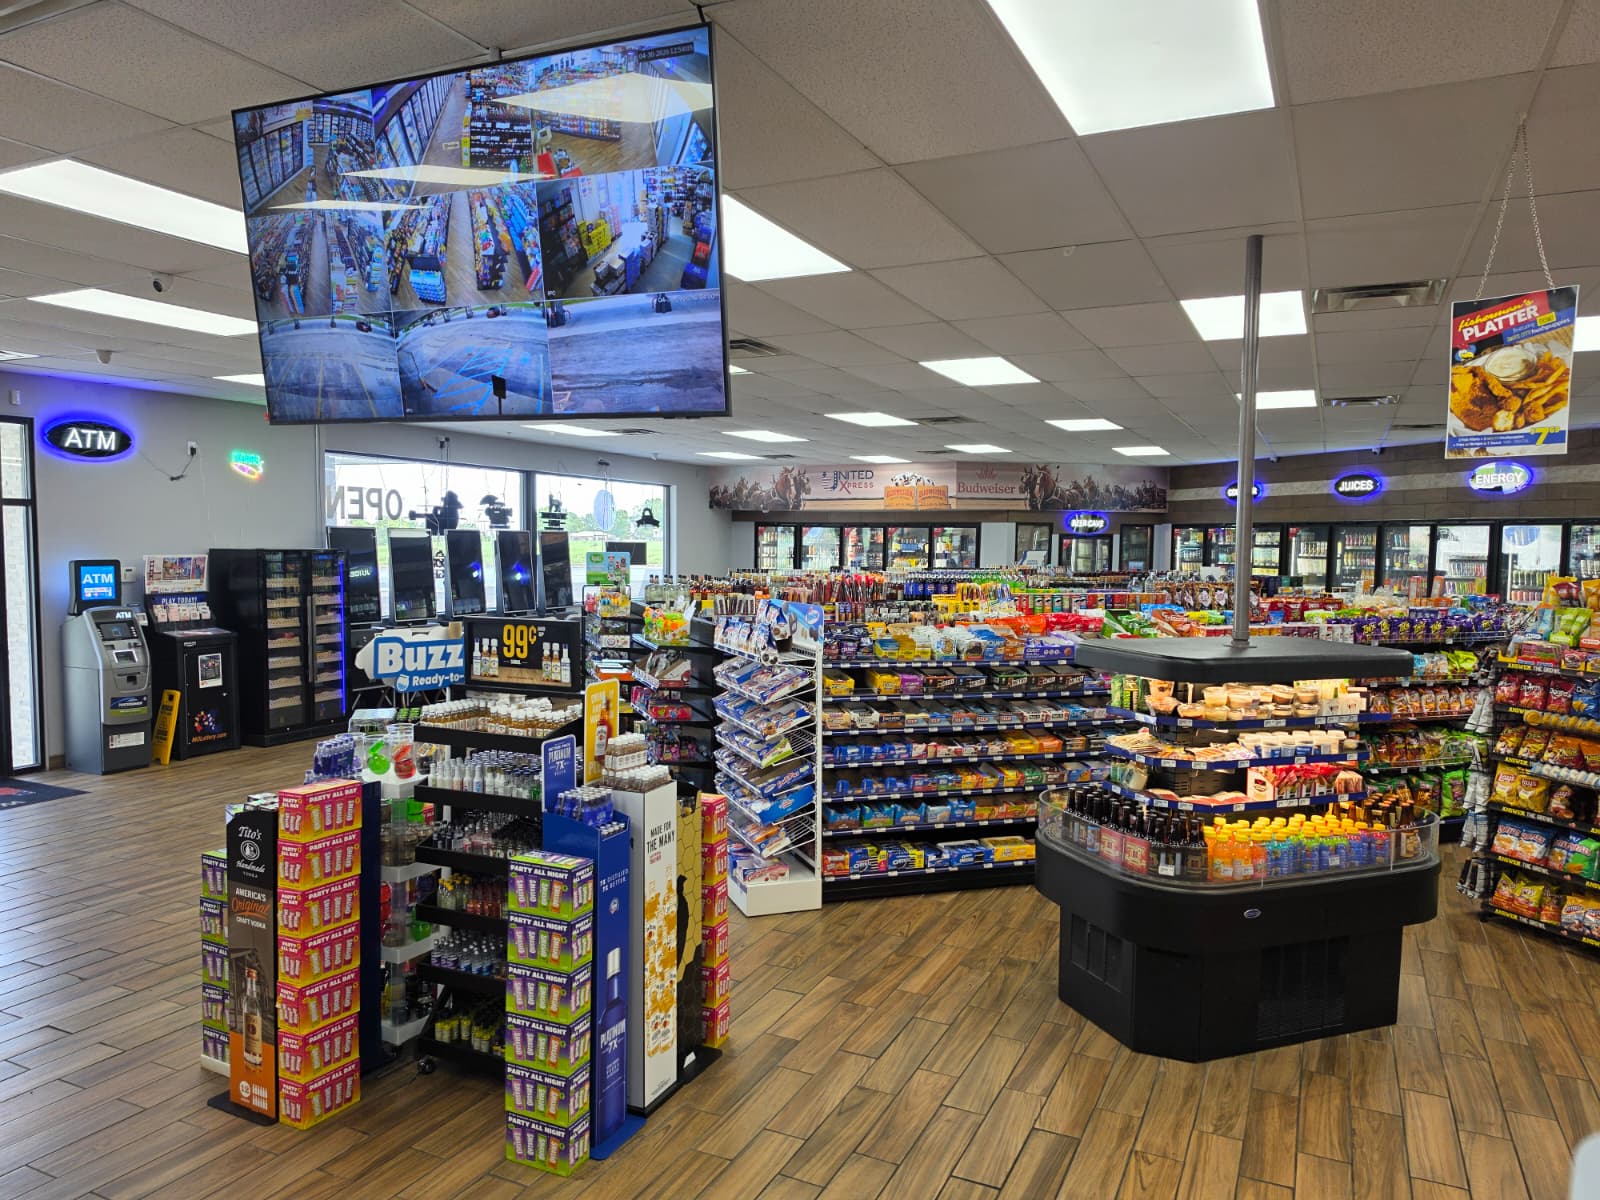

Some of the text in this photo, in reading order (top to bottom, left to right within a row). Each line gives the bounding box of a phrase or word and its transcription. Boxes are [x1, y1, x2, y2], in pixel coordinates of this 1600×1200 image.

[1462, 305, 1540, 341] PLATTER
[64, 427, 116, 451] ATM
[1338, 480, 1374, 491] JUICES
[1475, 472, 1523, 484] ENERGY
[957, 482, 1016, 494] Budweiser
[82, 573, 113, 584] ATM
[116, 611, 132, 619] ATM
[377, 642, 464, 674] Buzz
[309, 788, 357, 803] PARTY ALL DAY
[1503, 806, 1526, 816] ANSWER
[238, 826, 262, 840] Tito's
[650, 820, 671, 837] MADE FOR
[309, 834, 356, 851] PARTY ALL DAY
[646, 831, 675, 854] THE MANY
[236, 860, 266, 873] Handmade
[1498, 856, 1521, 867] ANSWER
[511, 865, 532, 873] PARTY
[547, 871, 568, 879] NIGHT
[235, 887, 266, 902] AMERICA'S
[308, 880, 355, 900] PARTY ALL DAY
[231, 897, 270, 914] Original
[1494, 909, 1518, 920] ANSWER
[510, 916, 532, 924] PARTY
[547, 922, 567, 931] NIGHT
[308, 926, 355, 948] PARTY ALL DAY
[509, 967, 567, 984] PARTY ALL NIGHT
[306, 973, 355, 996] PARTY ALL DAY
[309, 1019, 354, 1044] PARTY ALL DAY
[508, 1017, 566, 1035] PARTY ALL NIGHT
[600, 1018, 626, 1048] PLATINUM
[608, 1039, 618, 1054] 7X
[309, 1064, 356, 1091] PARTY ALL DAY
[507, 1067, 566, 1087] PARTY ALL NIGHT
[508, 1116, 565, 1138] PARTY ALL NIGHT
